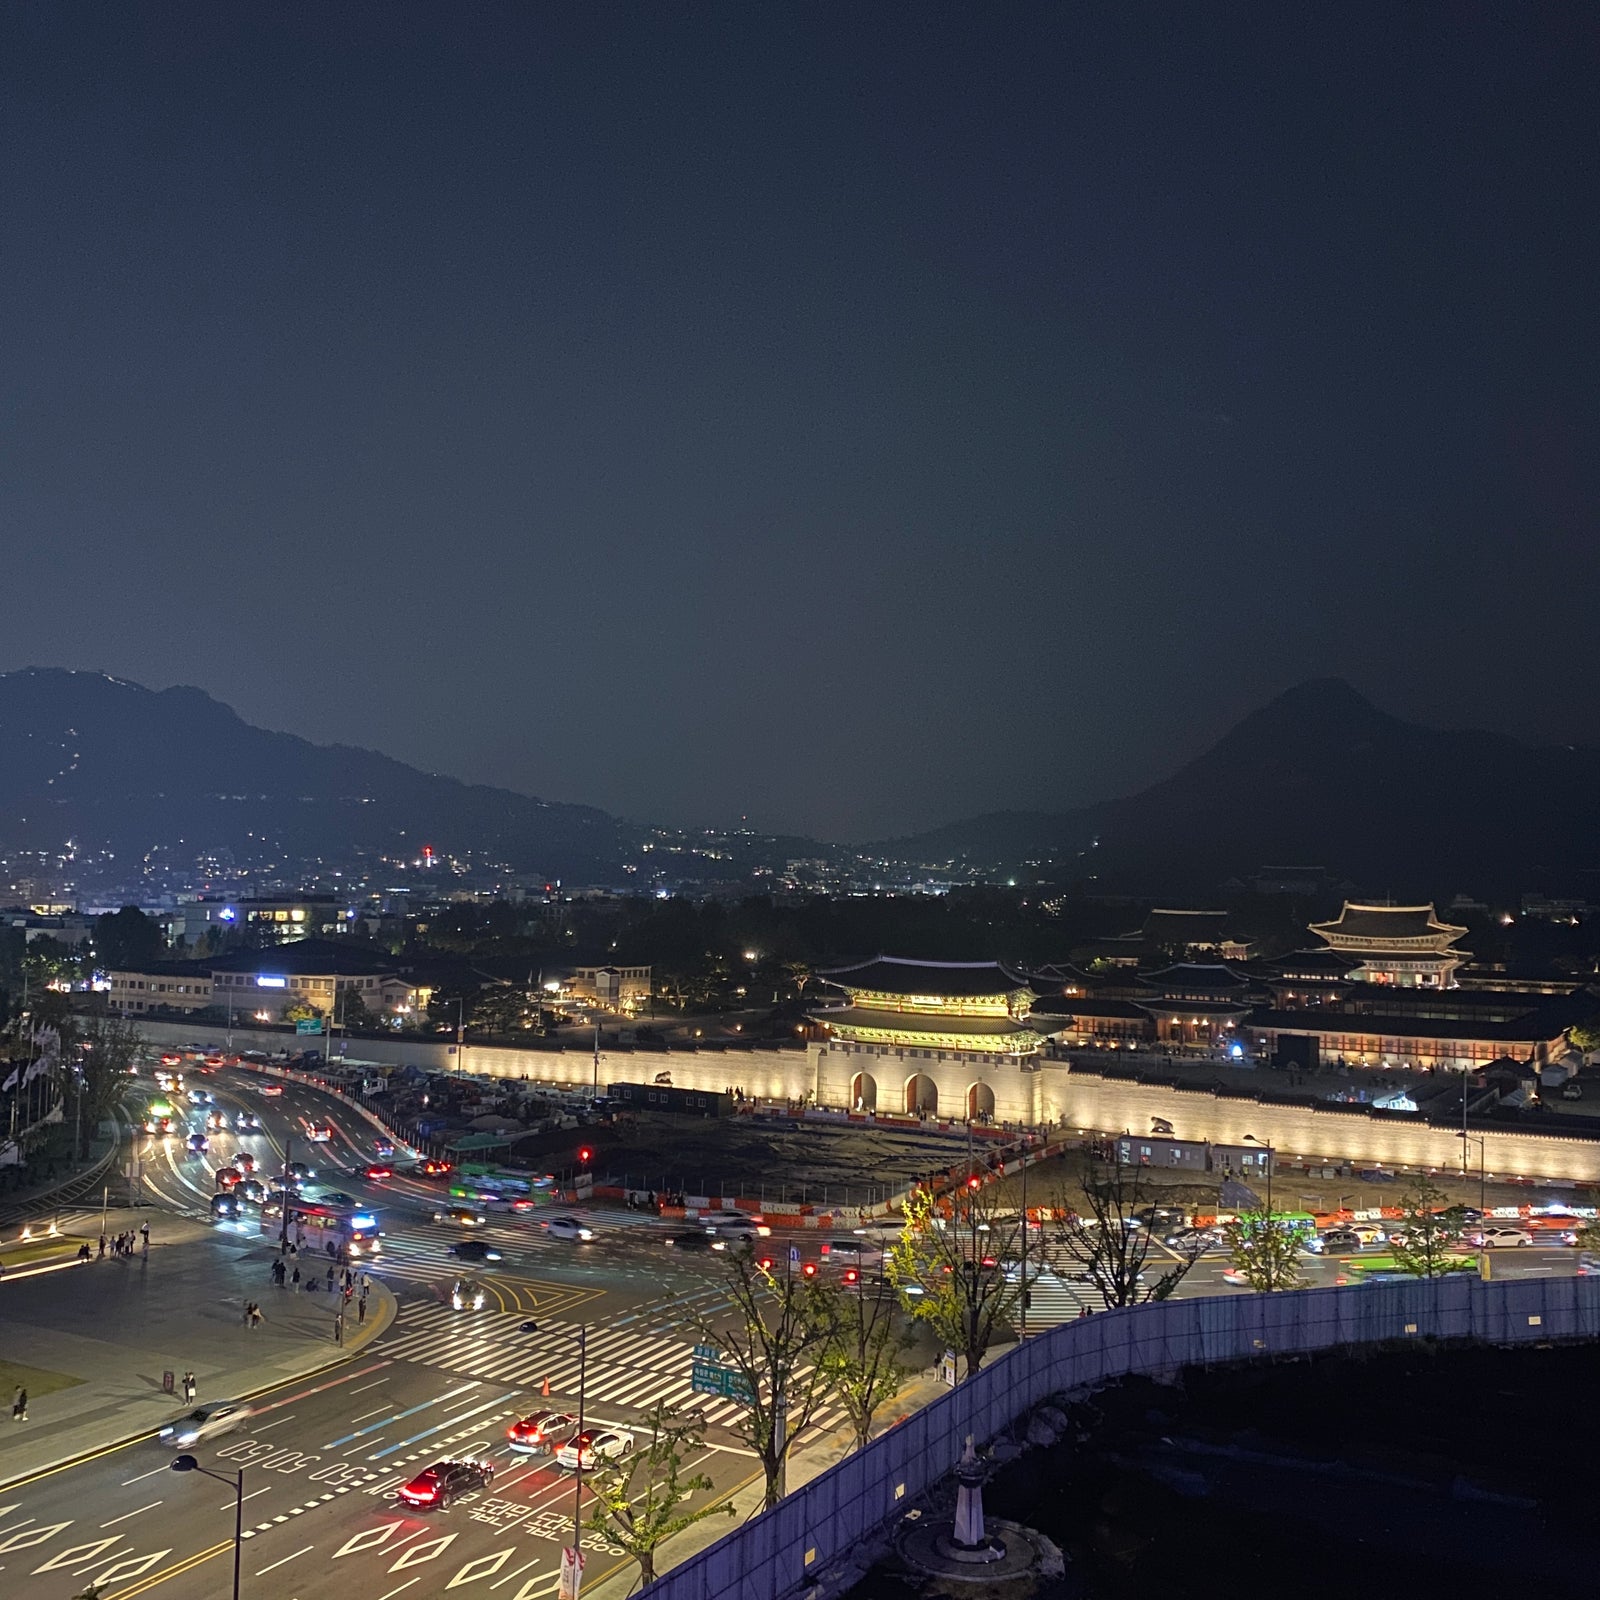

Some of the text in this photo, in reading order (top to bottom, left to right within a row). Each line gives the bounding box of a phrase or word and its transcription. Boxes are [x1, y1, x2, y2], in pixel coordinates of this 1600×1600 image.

[216, 1440, 274, 1461] 50
[262, 1452, 321, 1473] 50
[308, 1463, 367, 1485] 50
[467, 1498, 532, 1527] 독립문
